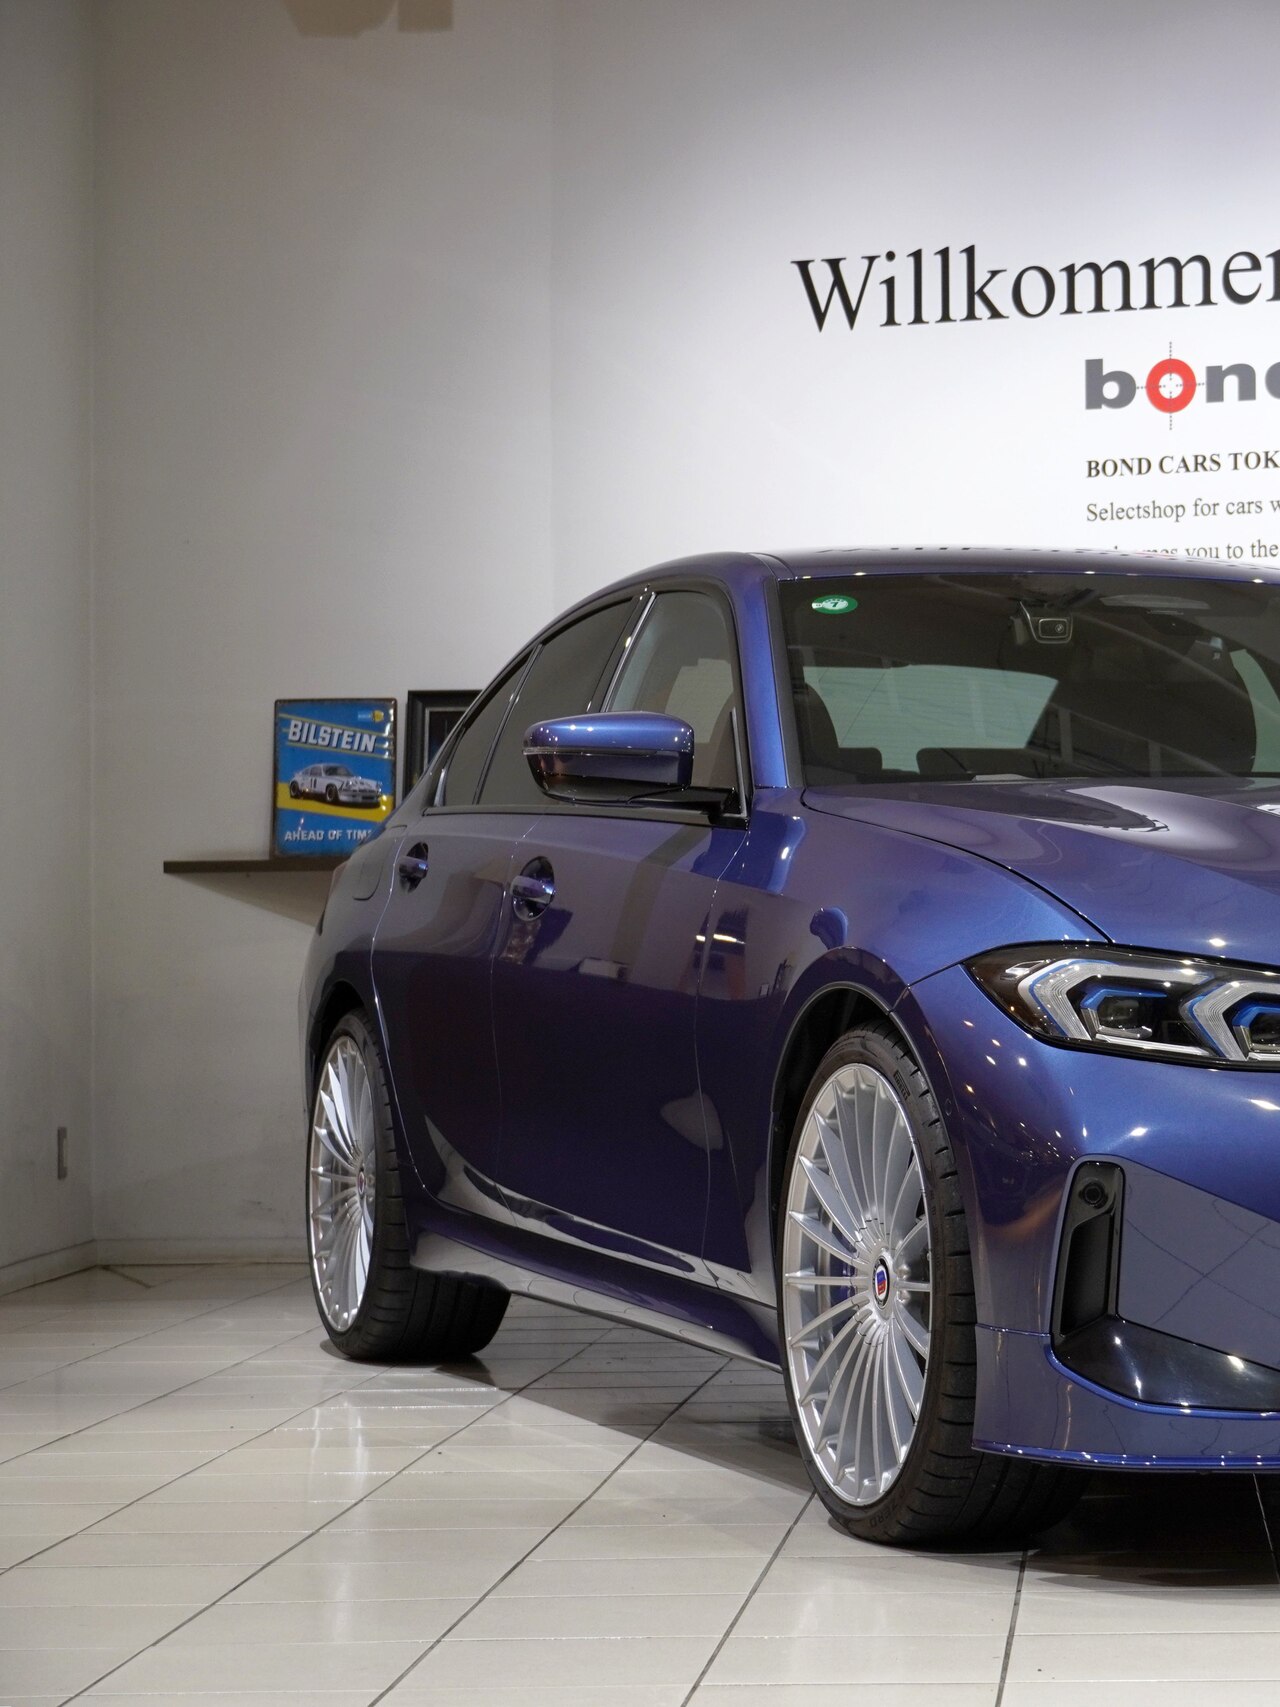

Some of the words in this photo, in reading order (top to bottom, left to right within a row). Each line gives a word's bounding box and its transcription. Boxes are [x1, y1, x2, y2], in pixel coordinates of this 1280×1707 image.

[1086, 456, 1152, 478] BOND
[1158, 453, 1222, 475] CARS
[1086, 500, 1186, 523] Selectshop
[1193, 497, 1220, 517] for
[1225, 501, 1263, 516] cars
[1226, 544, 1244, 560] to
[1250, 538, 1279, 559] the
[288, 719, 377, 753] BILSTEIN
[284, 829, 325, 842] AHEAD
[328, 829, 342, 841] OF
